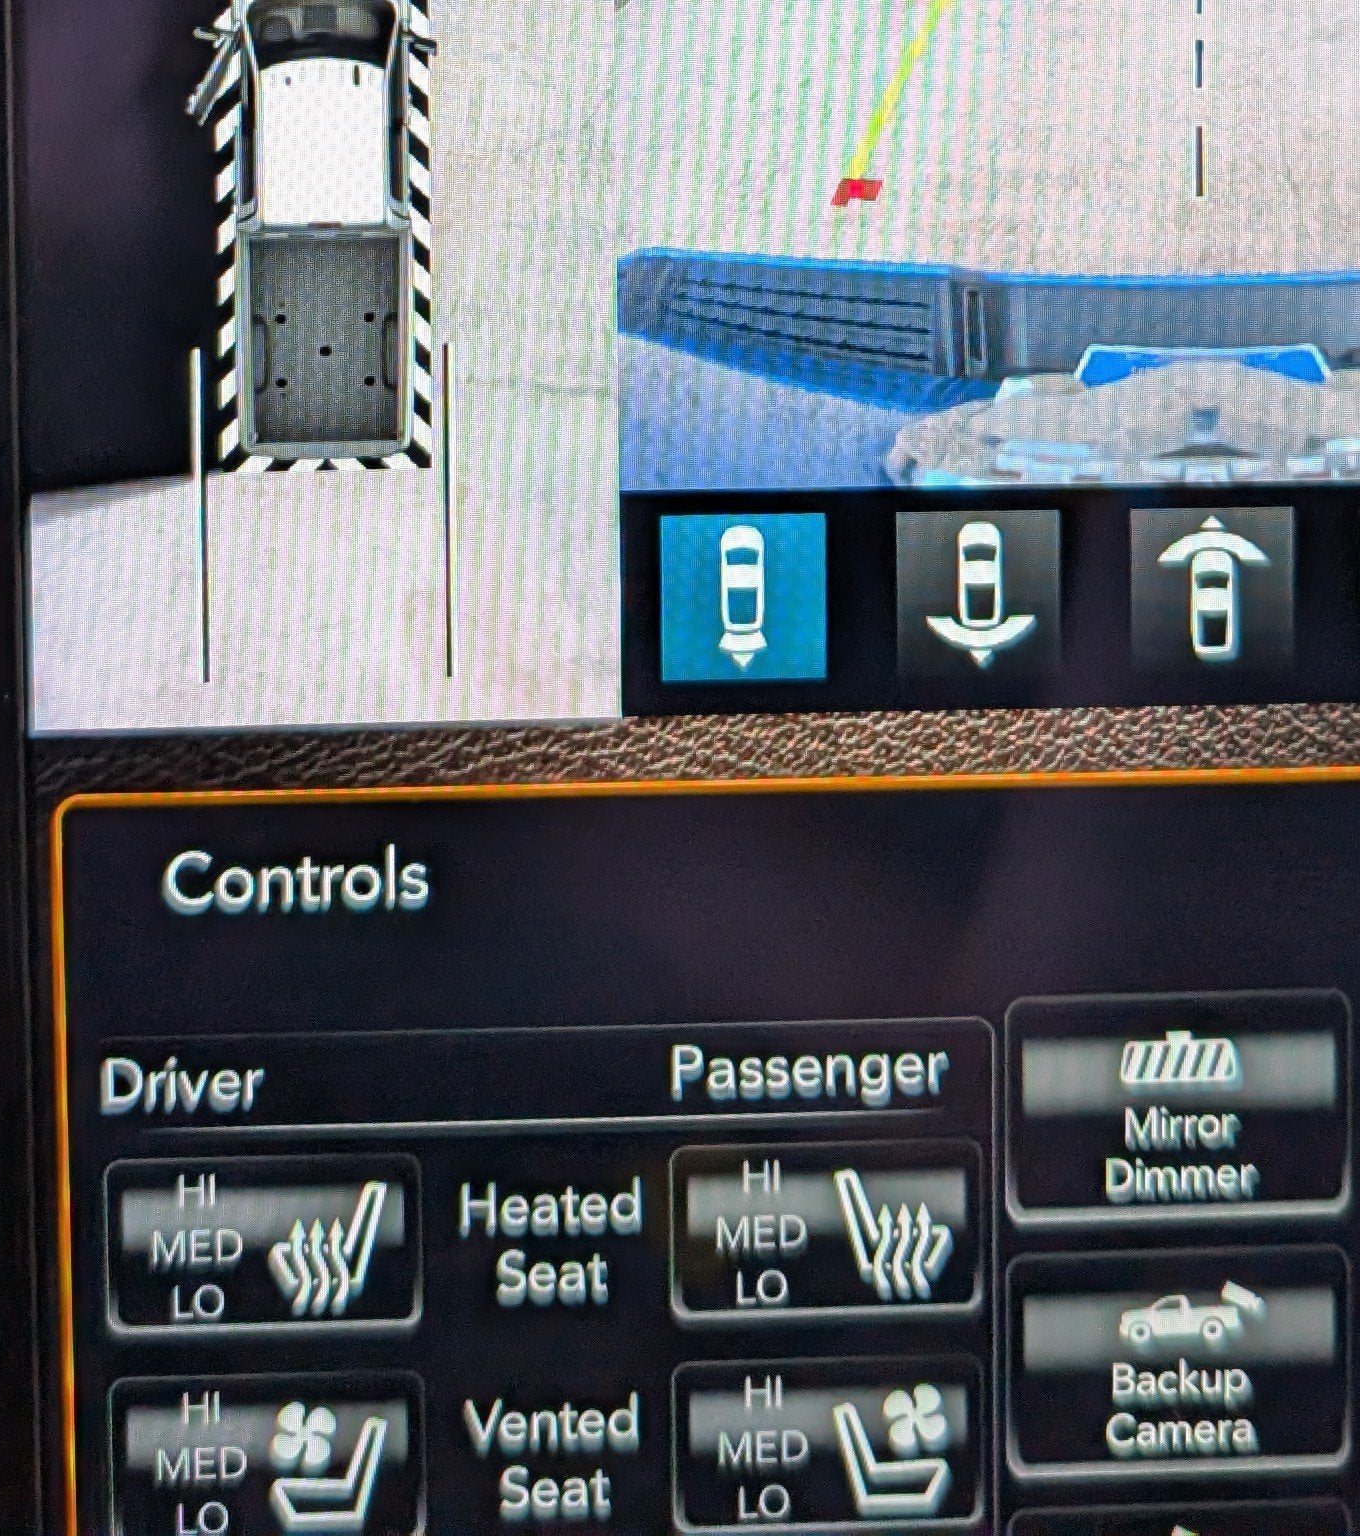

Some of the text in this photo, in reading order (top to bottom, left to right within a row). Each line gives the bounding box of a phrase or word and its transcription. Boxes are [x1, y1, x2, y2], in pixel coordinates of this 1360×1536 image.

[163, 844, 429, 913] Controls
[100, 1057, 264, 1114] Driver
[670, 1044, 950, 1104] Passenger
[1124, 1108, 1239, 1150] Mirror
[179, 1174, 217, 1206] HI
[743, 1159, 781, 1192] HI
[1105, 1158, 1257, 1202] Dimmer
[460, 1178, 642, 1239] Heated
[151, 1230, 243, 1265] MED
[715, 1216, 807, 1251] MED
[496, 1251, 609, 1306] Seat
[737, 1271, 788, 1306] LO
[173, 1285, 226, 1320] LO
[745, 1376, 783, 1408] HI
[1111, 1363, 1249, 1404] Backup
[183, 1392, 221, 1424] HI
[463, 1393, 639, 1453] Vented
[718, 1430, 809, 1467] MED
[1105, 1415, 1256, 1454] Camera
[155, 1446, 247, 1483] MED
[499, 1467, 610, 1519] Seat
[739, 1486, 790, 1521] LO
[176, 1502, 229, 1536] LO
